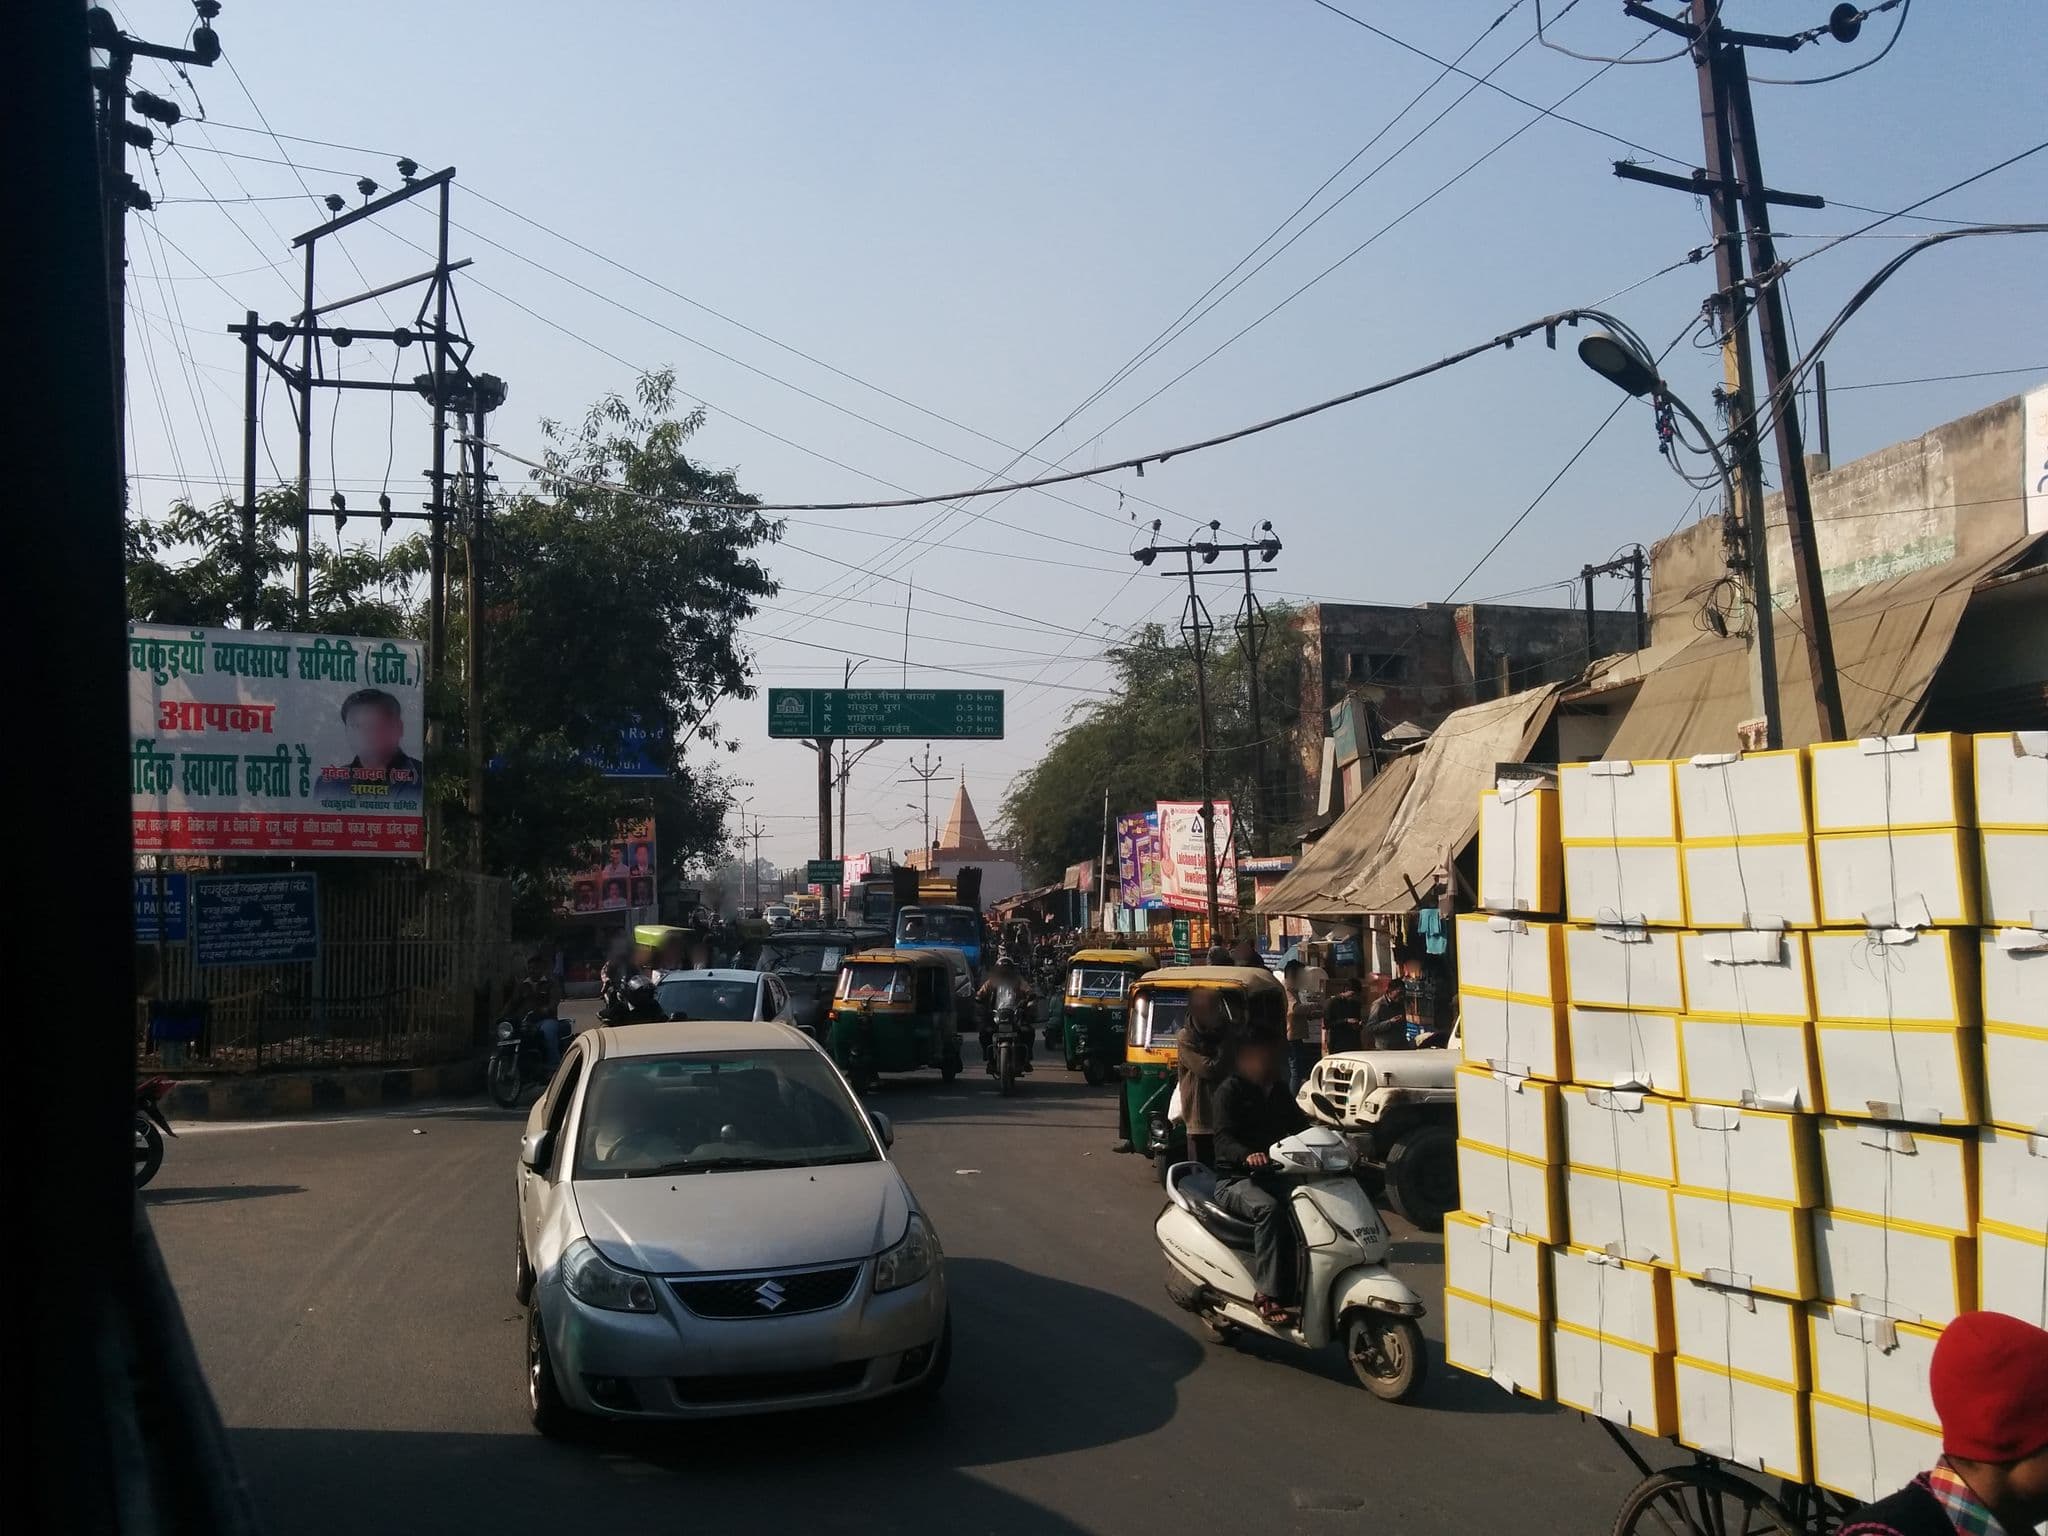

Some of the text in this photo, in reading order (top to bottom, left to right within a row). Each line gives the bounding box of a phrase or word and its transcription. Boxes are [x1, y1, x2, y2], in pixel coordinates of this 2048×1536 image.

[212, 642, 291, 678] व्यवसाय
[296, 638, 358, 682] समिति
[364, 641, 421, 689] (रजि.)
[905, 692, 936, 701] बाजार
[957, 693, 973, 701] 1.0
[975, 692, 998, 701] km.
[847, 702, 998, 713] गोकुल पुरा 0.5 km.
[158, 701, 276, 733] आपका
[975, 713, 998, 722] km.
[847, 722, 876, 734] पुलिस
[956, 724, 972, 733] 0.7
[975, 724, 998, 733] km.
[131, 738, 175, 796] र्दिक
[180, 753, 239, 797] स्वागत
[244, 743, 292, 797] करती
